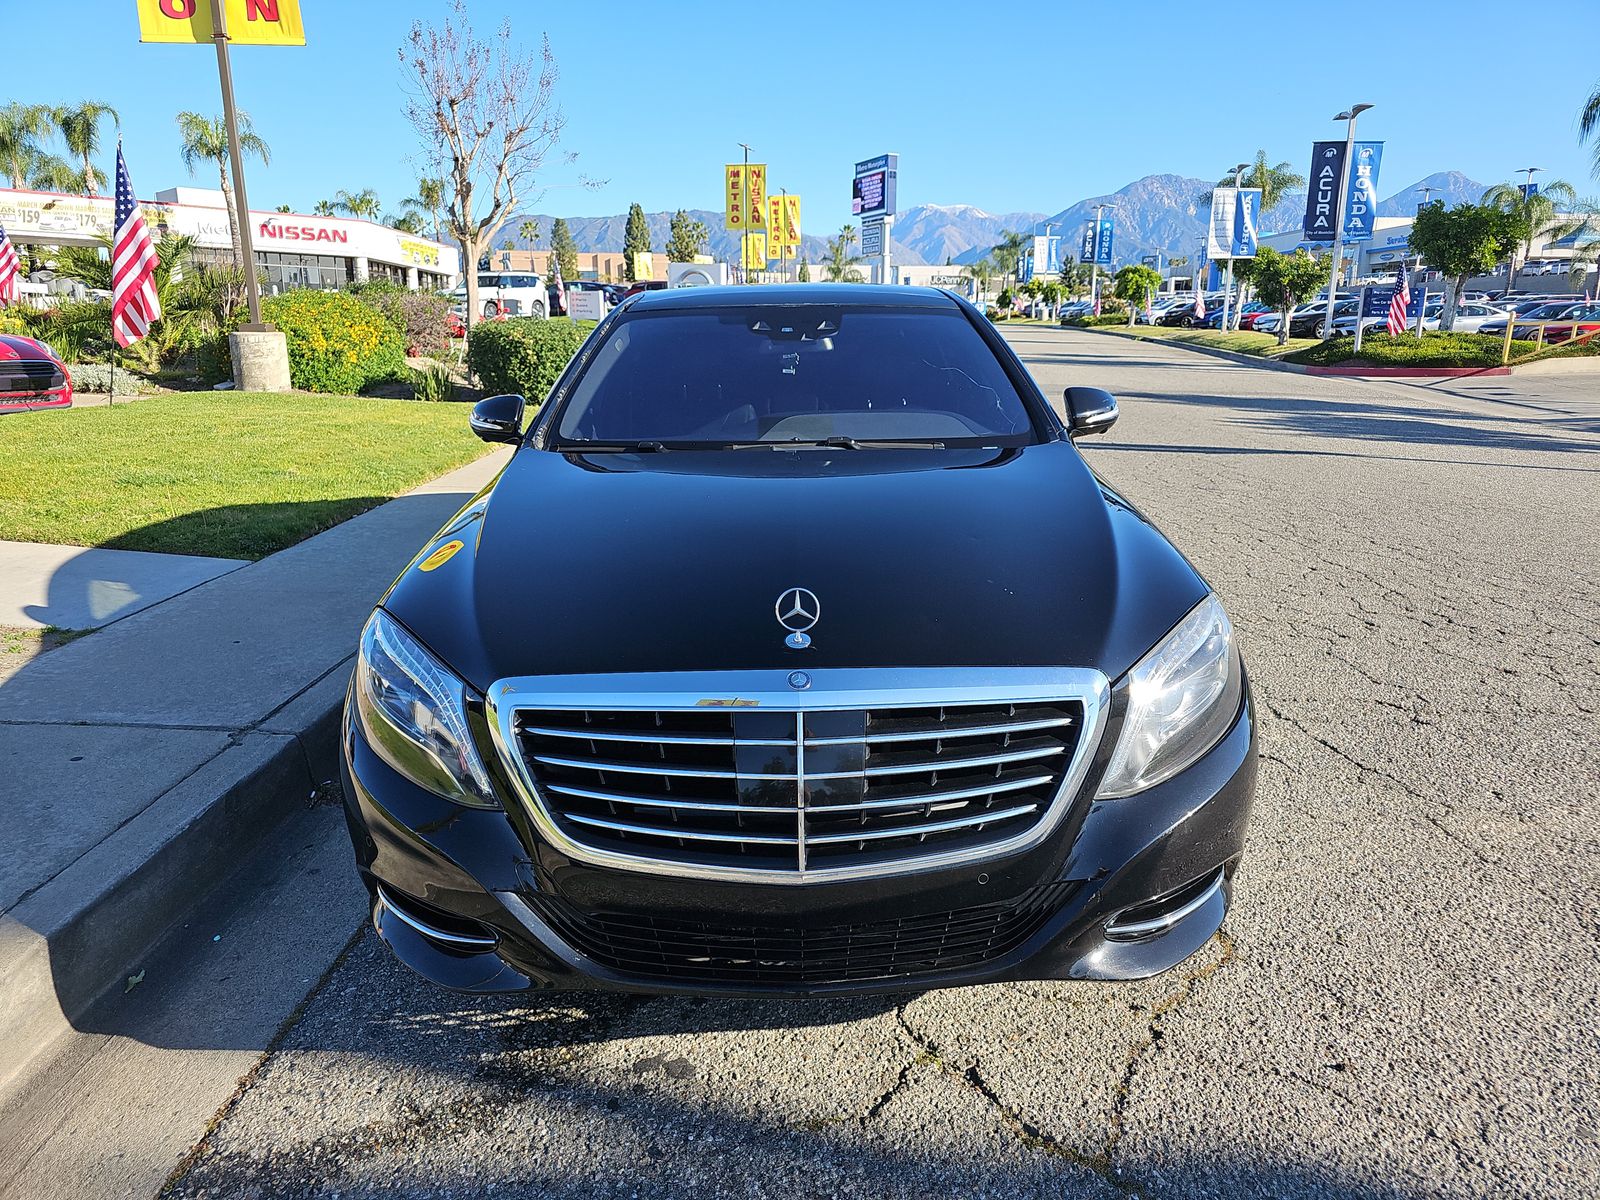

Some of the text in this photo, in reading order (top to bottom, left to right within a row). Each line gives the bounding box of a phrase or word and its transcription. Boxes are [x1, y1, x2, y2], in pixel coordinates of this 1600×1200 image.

[18, 208, 40, 224] $159
[730, 170, 740, 223] METRO
[751, 169, 761, 223] NISSAN
[1313, 165, 1334, 227] ACURA
[1347, 165, 1372, 228] HONDA
[259, 223, 347, 243] NISSAN
[772, 200, 780, 241] METRO
[1085, 230, 1094, 258] ACURA
[1101, 231, 1110, 259] HONDA
